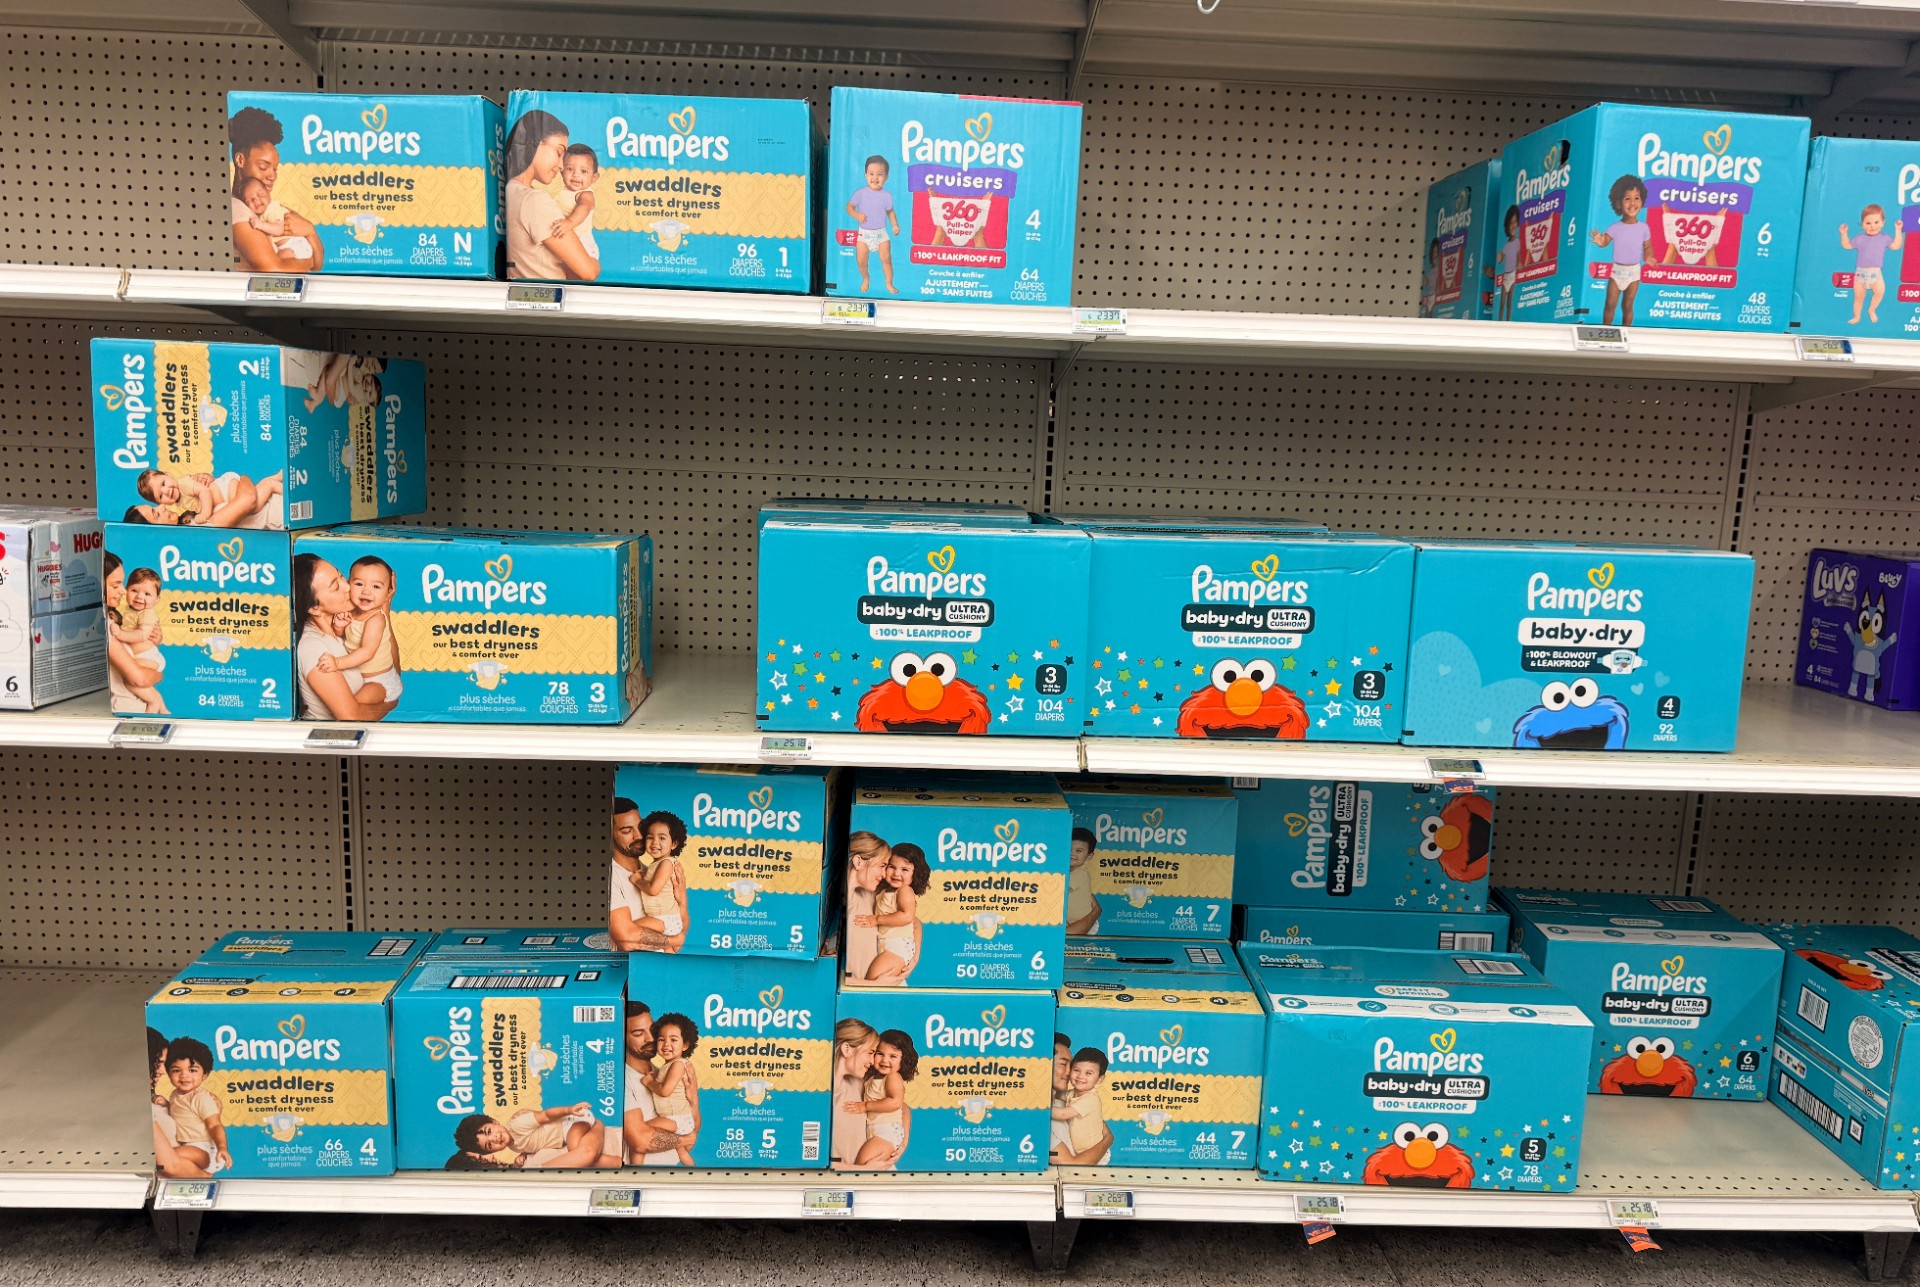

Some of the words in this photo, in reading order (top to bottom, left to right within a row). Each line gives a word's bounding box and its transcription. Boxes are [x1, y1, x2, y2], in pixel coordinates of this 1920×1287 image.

[301, 114, 420, 160] Pampers
[606, 116, 729, 164] Pampers
[902, 120, 1024, 171] Pampers
[1638, 133, 1762, 186] Pampers
[312, 171, 414, 190] swaddlers
[615, 176, 722, 197] swaddlers
[925, 172, 1002, 190] cruisers
[1516, 165, 1570, 204] Pampers
[330, 191, 358, 201] best
[362, 192, 413, 202] dryness
[1659, 187, 1738, 205] cruisers
[1524, 197, 1559, 218] cruisers
[946, 221, 974, 229] Pull-On
[1026, 210, 1041, 230] 4
[1437, 208, 1471, 237] Pampers
[1568, 217, 1576, 236] 6
[418, 233, 437, 246] 84
[947, 228, 972, 237] Diaper
[1758, 223, 1772, 244] 6
[454, 232, 472, 253] N
[738, 244, 757, 257] 96
[1442, 234, 1464, 250] cruisers
[1679, 239, 1707, 247] Pull-On
[1679, 246, 1704, 254] Diaper
[412, 247, 444, 256] DIAPERS
[779, 247, 788, 266] 1
[938, 252, 987, 262] LEAKPROOF
[989, 254, 1002, 263] FIT
[410, 256, 447, 266] COUCHES
[1468, 253, 1474, 269] 6
[1021, 269, 1038, 280] 64
[1668, 272, 1717, 282] LEAKPROOF
[1719, 274, 1732, 283] FIT
[942, 288, 964, 296] SANS
[966, 289, 992, 298] FUITES
[1560, 284, 1571, 298] 48
[1748, 292, 1766, 304] 48
[239, 360, 259, 375] 2
[113, 353, 151, 469] Pampers
[160, 362, 180, 464] swaddlers
[261, 424, 272, 441] 84
[300, 426, 307, 447] 84
[365, 405, 374, 504] swaddlers
[385, 394, 401, 504] Pampers
[299, 469, 308, 486] 2
[37, 563, 62, 573] HUGGIES
[160, 545, 275, 588] Pampers
[422, 564, 547, 609] Pampers
[867, 556, 986, 600] Pampers
[1192, 565, 1308, 607] Pampers
[1527, 572, 1643, 616] Pampers
[169, 598, 269, 616] swaddlers
[950, 605, 986, 614] ULTRA
[187, 614, 215, 625] best
[219, 616, 269, 628] dryness
[1270, 620, 1307, 628] CUSHIONY
[1272, 612, 1306, 621] ULTRA
[432, 620, 540, 639] swaddlers
[906, 629, 972, 639] LEAKPROOF
[1228, 636, 1292, 645] LEAKPROOF
[1537, 659, 1590, 668] LEAKPROOF
[1552, 651, 1597, 660] BLOWOUT
[1045, 667, 1057, 684] 3
[1807, 664, 1814, 675] 4
[5, 675, 18, 693] 6
[262, 678, 277, 698] 2
[549, 682, 569, 695] 78
[1363, 673, 1375, 689] 3
[199, 694, 215, 706] 84
[590, 682, 605, 702] 3
[1038, 699, 1063, 712] 104
[1355, 705, 1380, 717] 104
[1663, 698, 1674, 711] 4
[1035, 712, 1065, 721] DIAPERS
[1659, 723, 1673, 734] 92
[1337, 786, 1346, 818] ULTRA
[693, 793, 801, 834] Pampers
[1096, 813, 1188, 848] Pampers
[1358, 797, 1369, 854] LEAKPROOF
[1291, 785, 1332, 889] Pampers
[698, 843, 793, 861] swaddlers
[938, 827, 1047, 867] Pampers
[1100, 856, 1180, 871] swaddlers
[943, 876, 1039, 894] swaddlers
[1175, 906, 1193, 916] 44
[1207, 905, 1220, 922] 7
[710, 934, 732, 949] 58
[790, 925, 803, 944] 5
[1260, 929, 1313, 946] Pampers
[964, 942, 982, 952] plus
[984, 941, 1013, 951] sèches
[1031, 951, 1045, 970] 6
[957, 964, 977, 977] 50
[1612, 962, 1707, 996] Pampers
[1676, 1000, 1704, 1008] ULTRA
[704, 993, 811, 1034] Pampers
[1639, 1017, 1692, 1026] LEAKPROOF
[926, 1014, 1035, 1052] Pampers
[215, 1025, 340, 1065] Pampers
[586, 1039, 601, 1053] 4
[710, 1043, 803, 1060] swaddlers
[1107, 1032, 1209, 1070] Pampers
[437, 1006, 478, 1115] Pampers
[489, 1013, 507, 1107] swaddlers
[1374, 1037, 1484, 1077] Pampers
[1743, 1052, 1753, 1064] 6
[931, 1062, 1026, 1078] swaddlers
[227, 1076, 334, 1093] swaddlers
[947, 1079, 974, 1088] best
[977, 1079, 1025, 1090] dryness
[1111, 1078, 1201, 1094] swaddlers
[1449, 1081, 1481, 1089] ULTRA
[1738, 1075, 1753, 1084] 64
[1448, 1088, 1482, 1096] CUSHIONY
[600, 1096, 615, 1116] 66
[1407, 1101, 1468, 1111] LEAKPROOF
[726, 1128, 744, 1140] 58
[762, 1128, 776, 1148] 5
[1196, 1132, 1216, 1144] 44
[1231, 1131, 1246, 1149] 7
[324, 1139, 343, 1151] 66
[360, 1137, 376, 1156] 4
[1020, 1134, 1034, 1153] 6
[1528, 1140, 1538, 1152] 5
[946, 1149, 966, 1162] 50
[1523, 1165, 1539, 1176] 78
